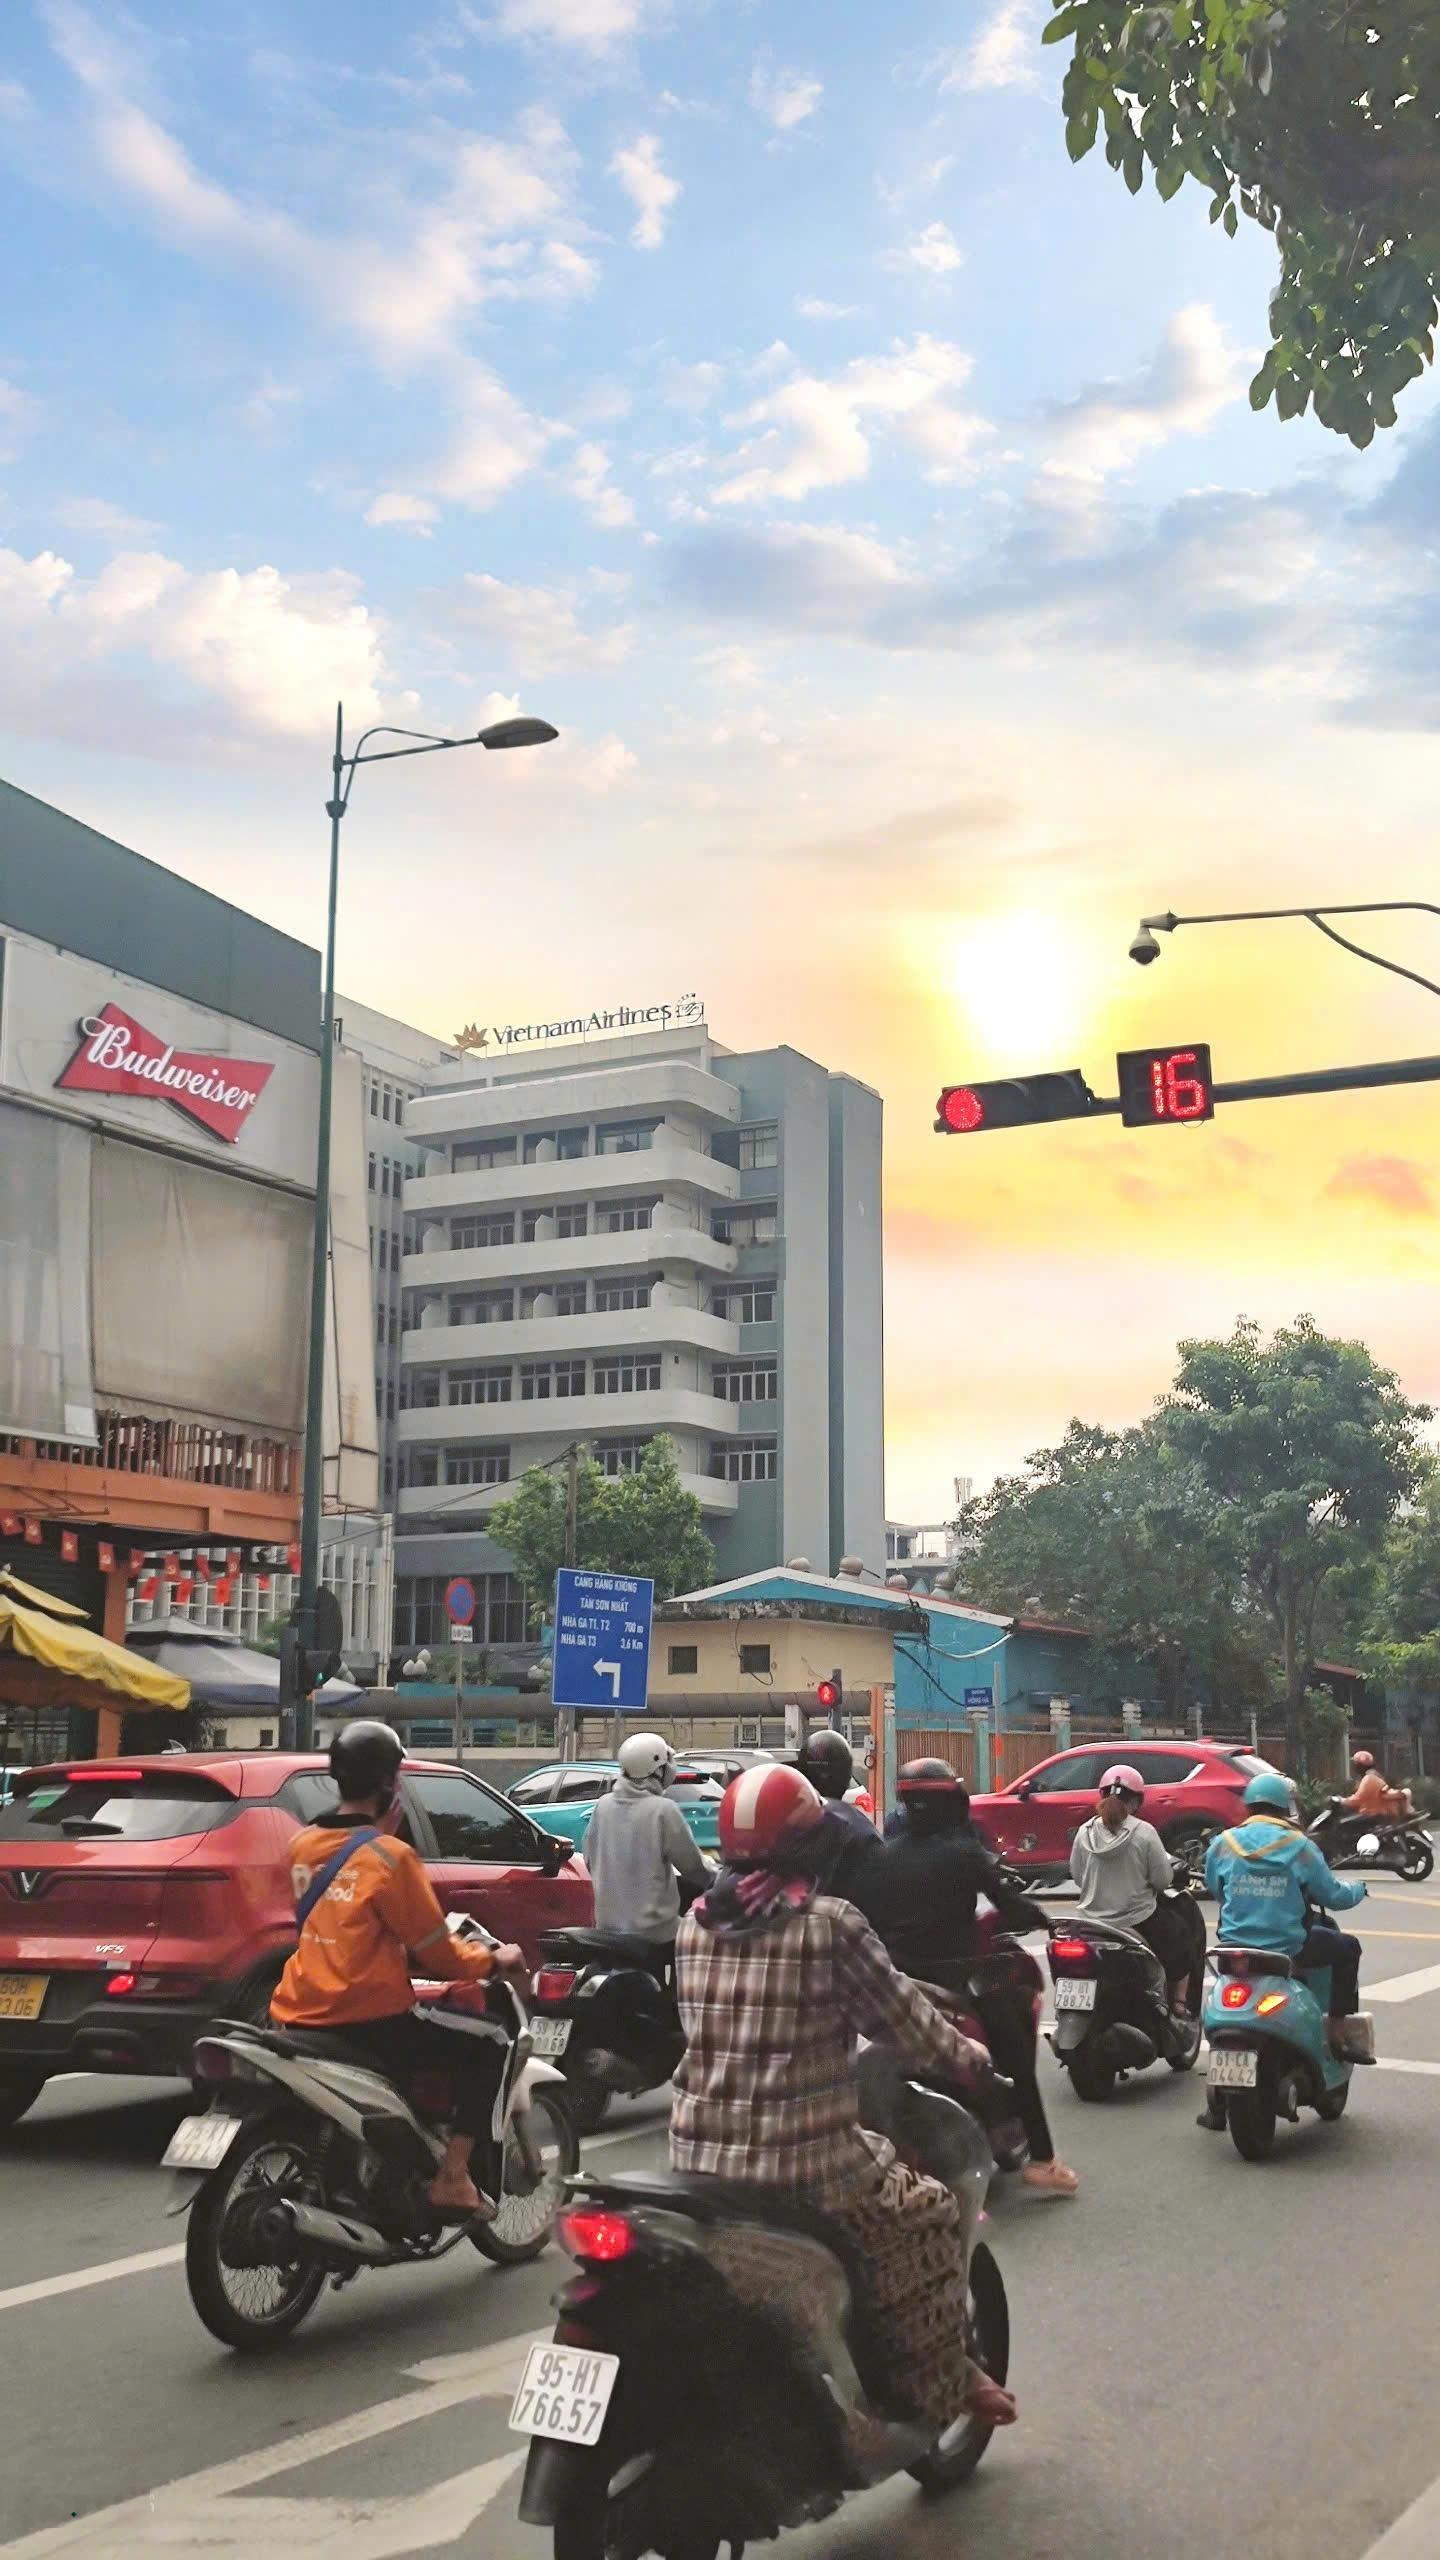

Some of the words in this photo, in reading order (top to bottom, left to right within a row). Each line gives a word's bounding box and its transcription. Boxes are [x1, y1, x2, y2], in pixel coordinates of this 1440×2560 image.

[493, 1018, 583, 1044] Vietnam
[587, 1005, 672, 1032] Airlines
[81, 1016, 257, 1110] Budweiser
[1152, 1053, 1206, 1117] 16
[576, 1634, 587, 1646] GA
[588, 1635, 597, 1647] T3
[578, 1617, 588, 1629] GA
[601, 1619, 610, 1631] T2
[624, 1621, 637, 1634] 700
[537, 2351, 603, 2395] 95-H1
[517, 2389, 602, 2437] 766.57
